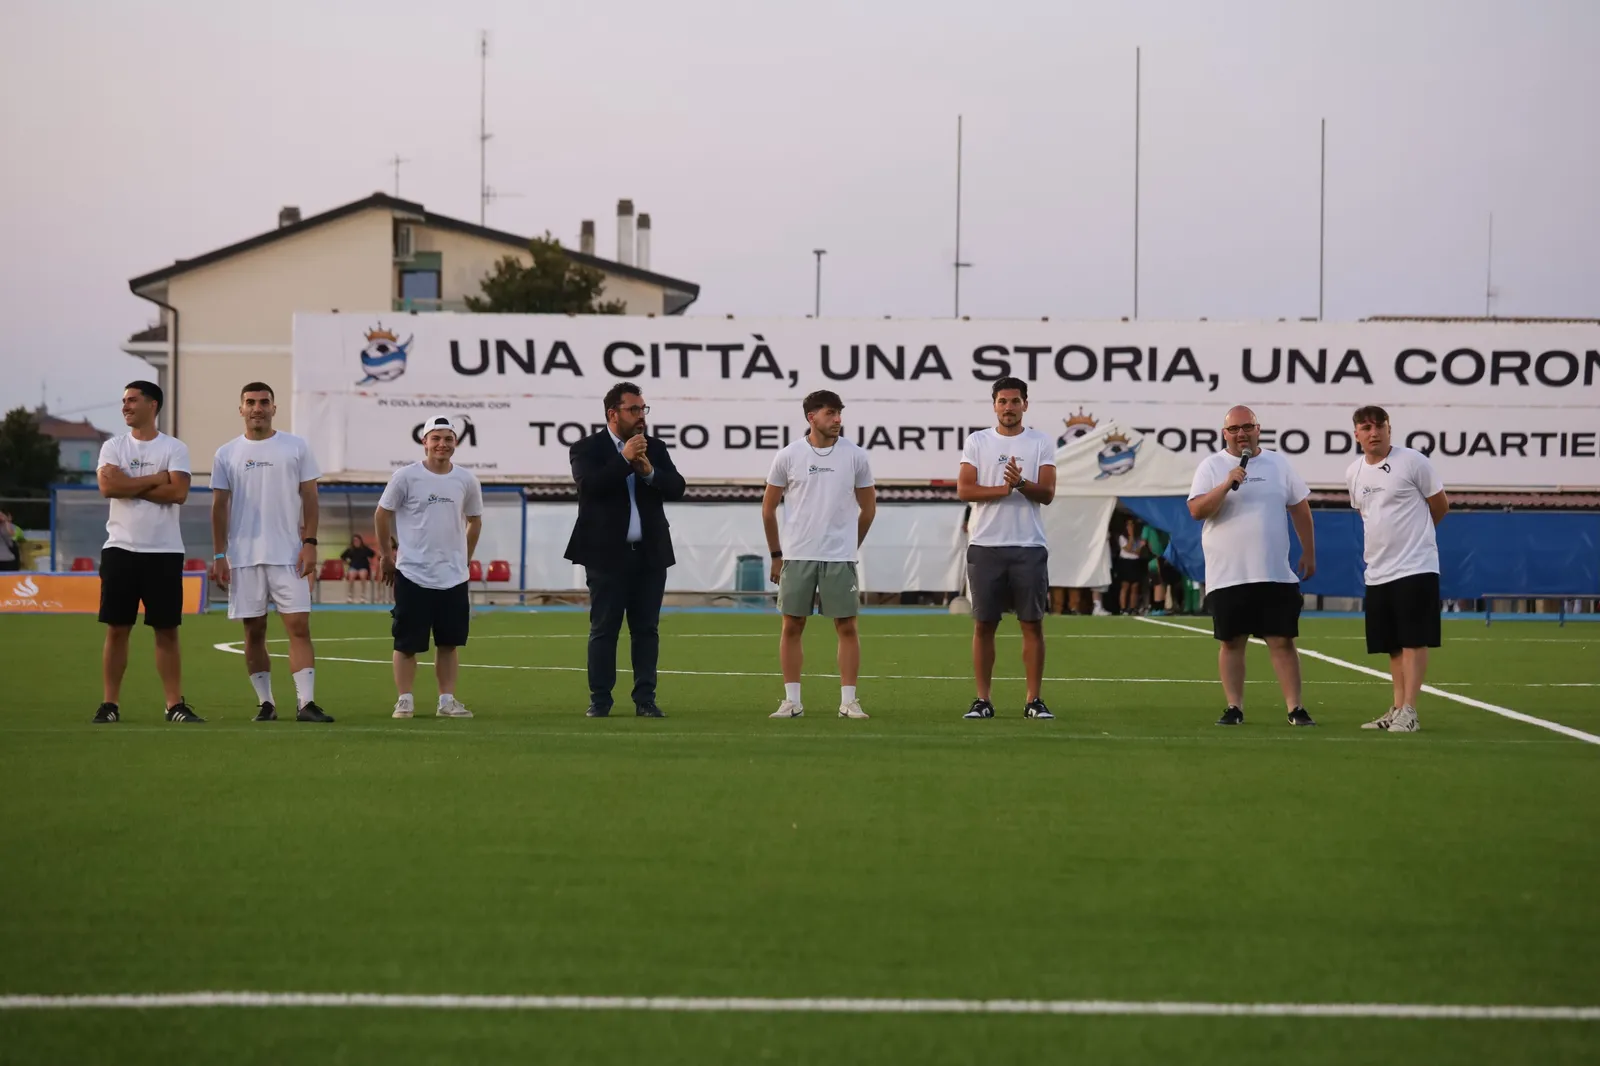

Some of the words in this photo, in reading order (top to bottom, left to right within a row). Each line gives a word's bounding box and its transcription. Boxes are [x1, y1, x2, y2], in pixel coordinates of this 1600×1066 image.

[449, 338, 584, 377] UNA
[603, 333, 799, 388] CITTÀ,
[820, 343, 953, 381] UNA
[971, 344, 1219, 391] STORIA,
[1241, 347, 1374, 385] UNA
[528, 422, 710, 450] TOEO
[724, 425, 789, 450] DEI
[1405, 430, 1600, 458] QUARTIE
